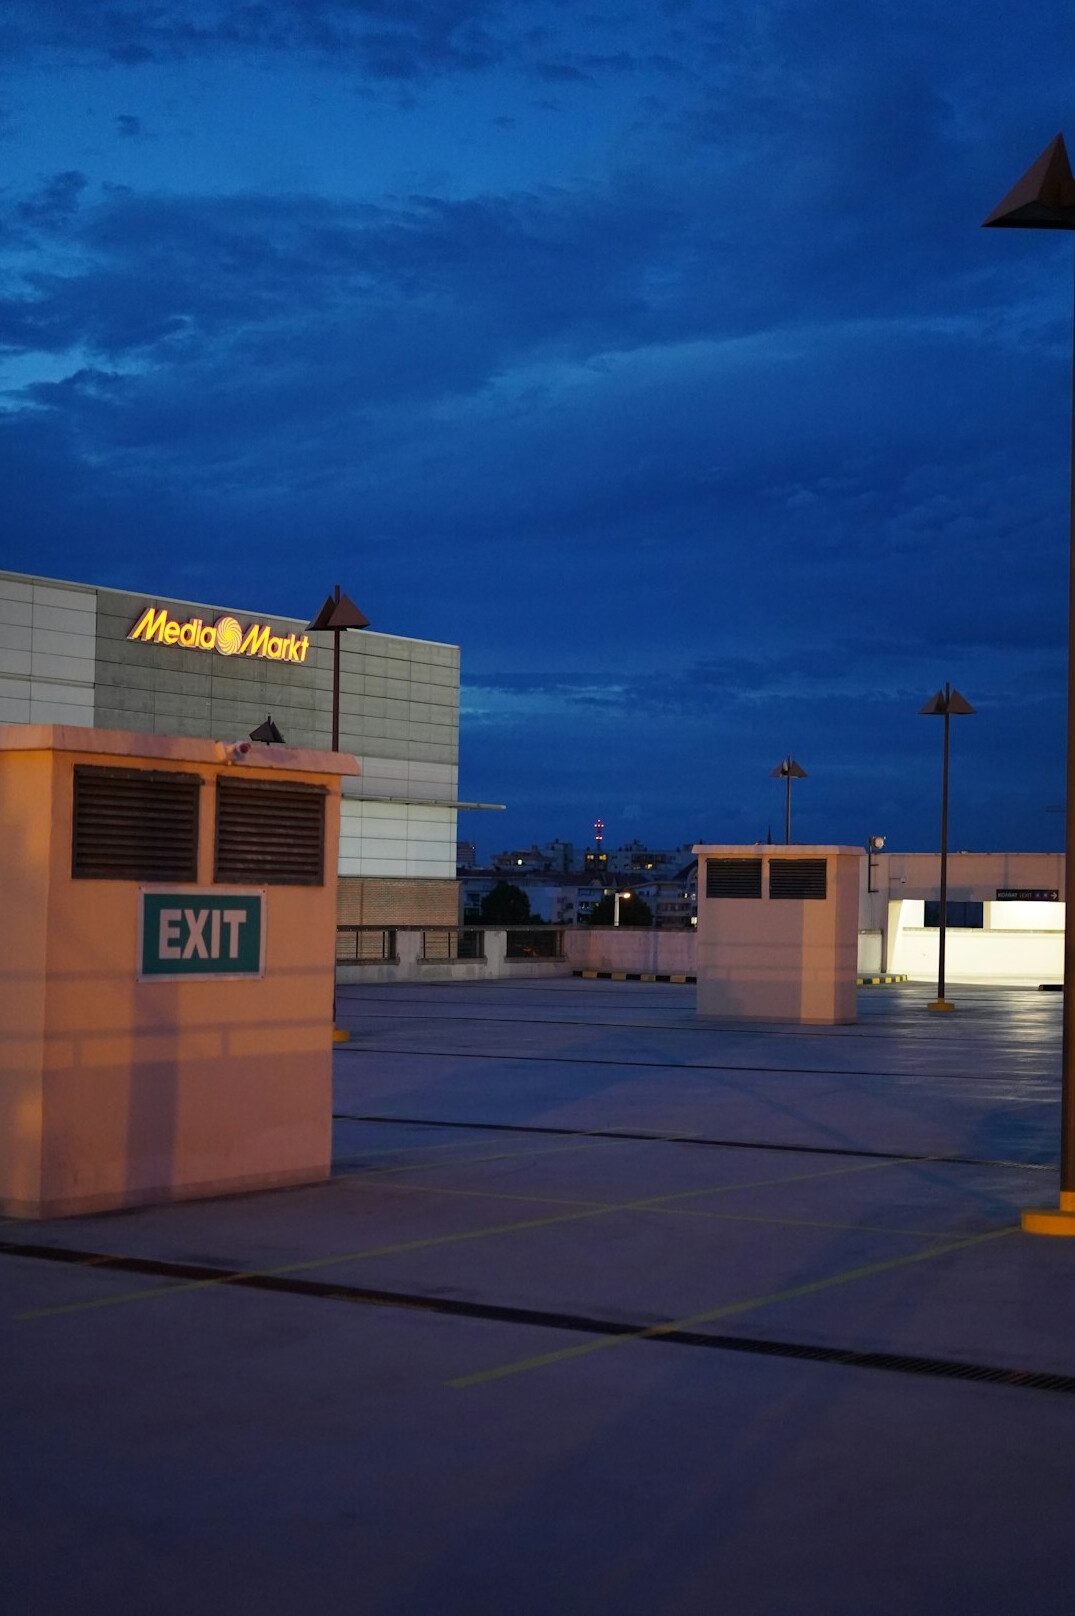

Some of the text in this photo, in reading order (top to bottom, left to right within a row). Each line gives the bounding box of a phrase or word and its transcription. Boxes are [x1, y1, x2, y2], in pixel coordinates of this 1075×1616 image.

[128, 607, 309, 662] Media Markt
[158, 908, 247, 959] EXIT
